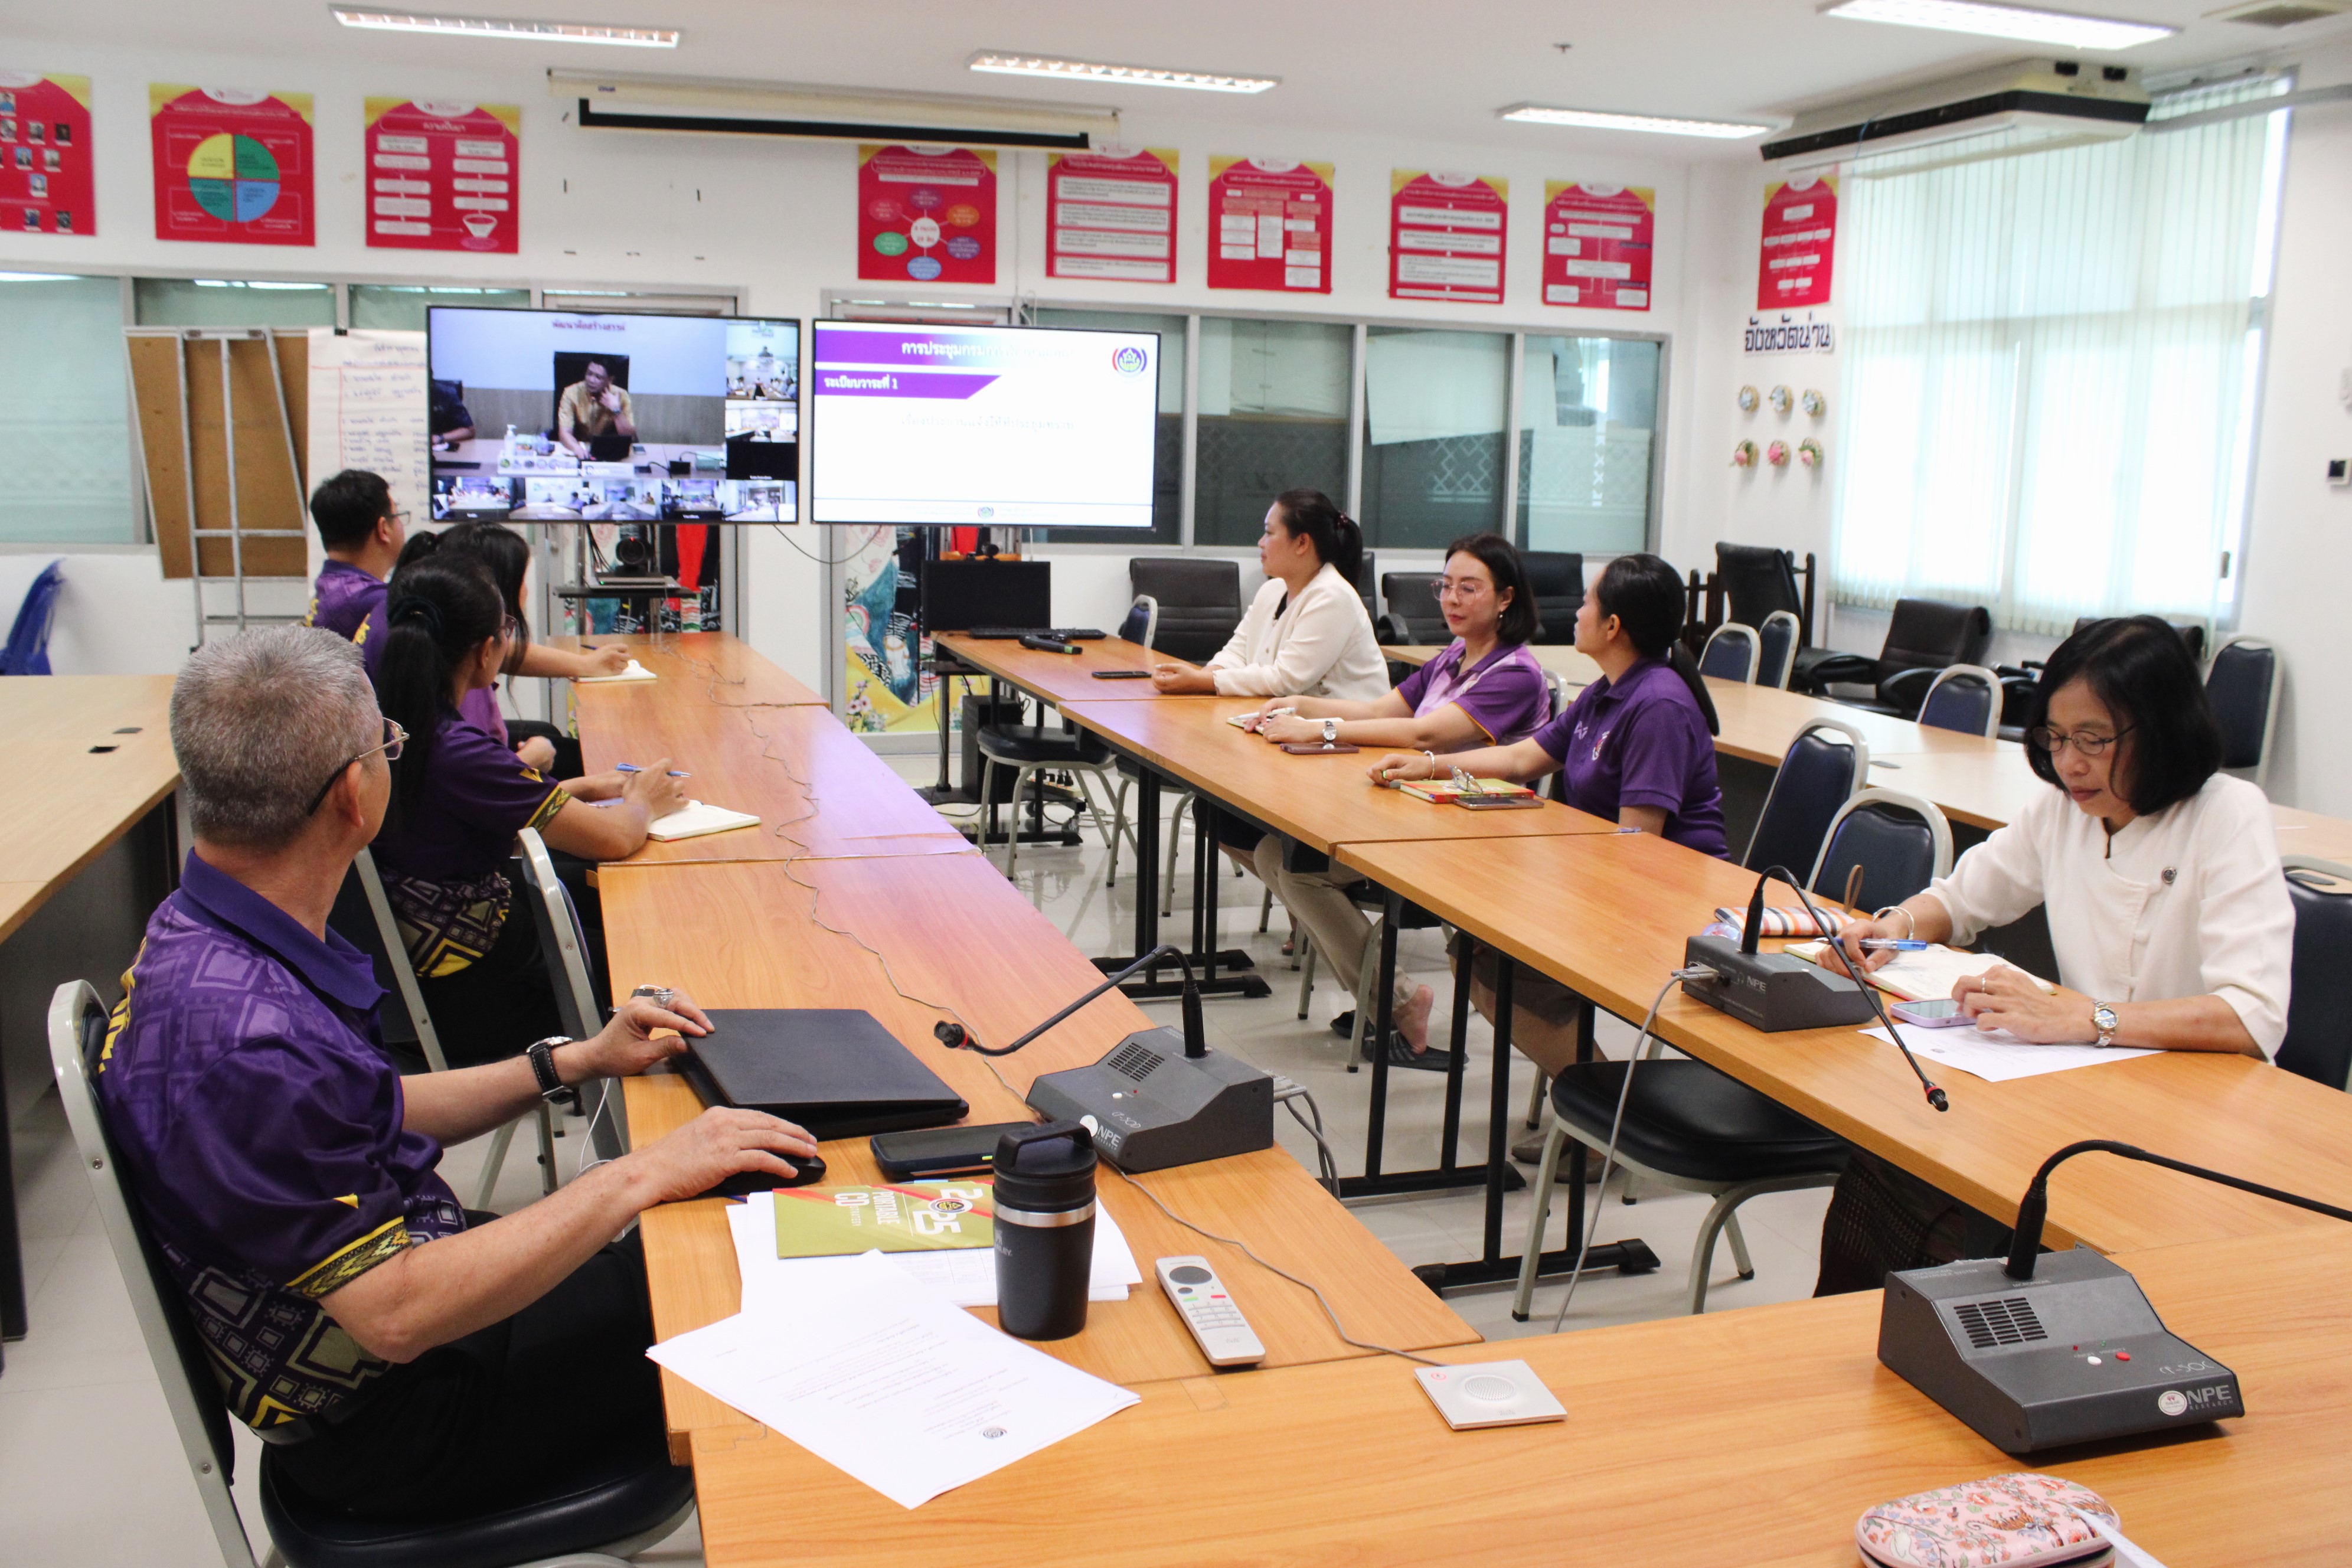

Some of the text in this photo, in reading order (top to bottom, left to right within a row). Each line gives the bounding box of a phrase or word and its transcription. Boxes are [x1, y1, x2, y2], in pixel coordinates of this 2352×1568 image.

[1745, 311, 1831, 351] จังหวัดน่าน
[824, 373, 898, 390] ระเบียบวาระที่ 1
[1747, 975, 1767, 992] NPE
[1097, 1125, 1122, 1148] NPE
[834, 1191, 870, 1227] CD STRATEGY
[872, 1190, 901, 1226] PORTABLE
[2186, 1384, 2232, 1405] NPE
[2188, 1400, 2234, 1411] RESEARCH
